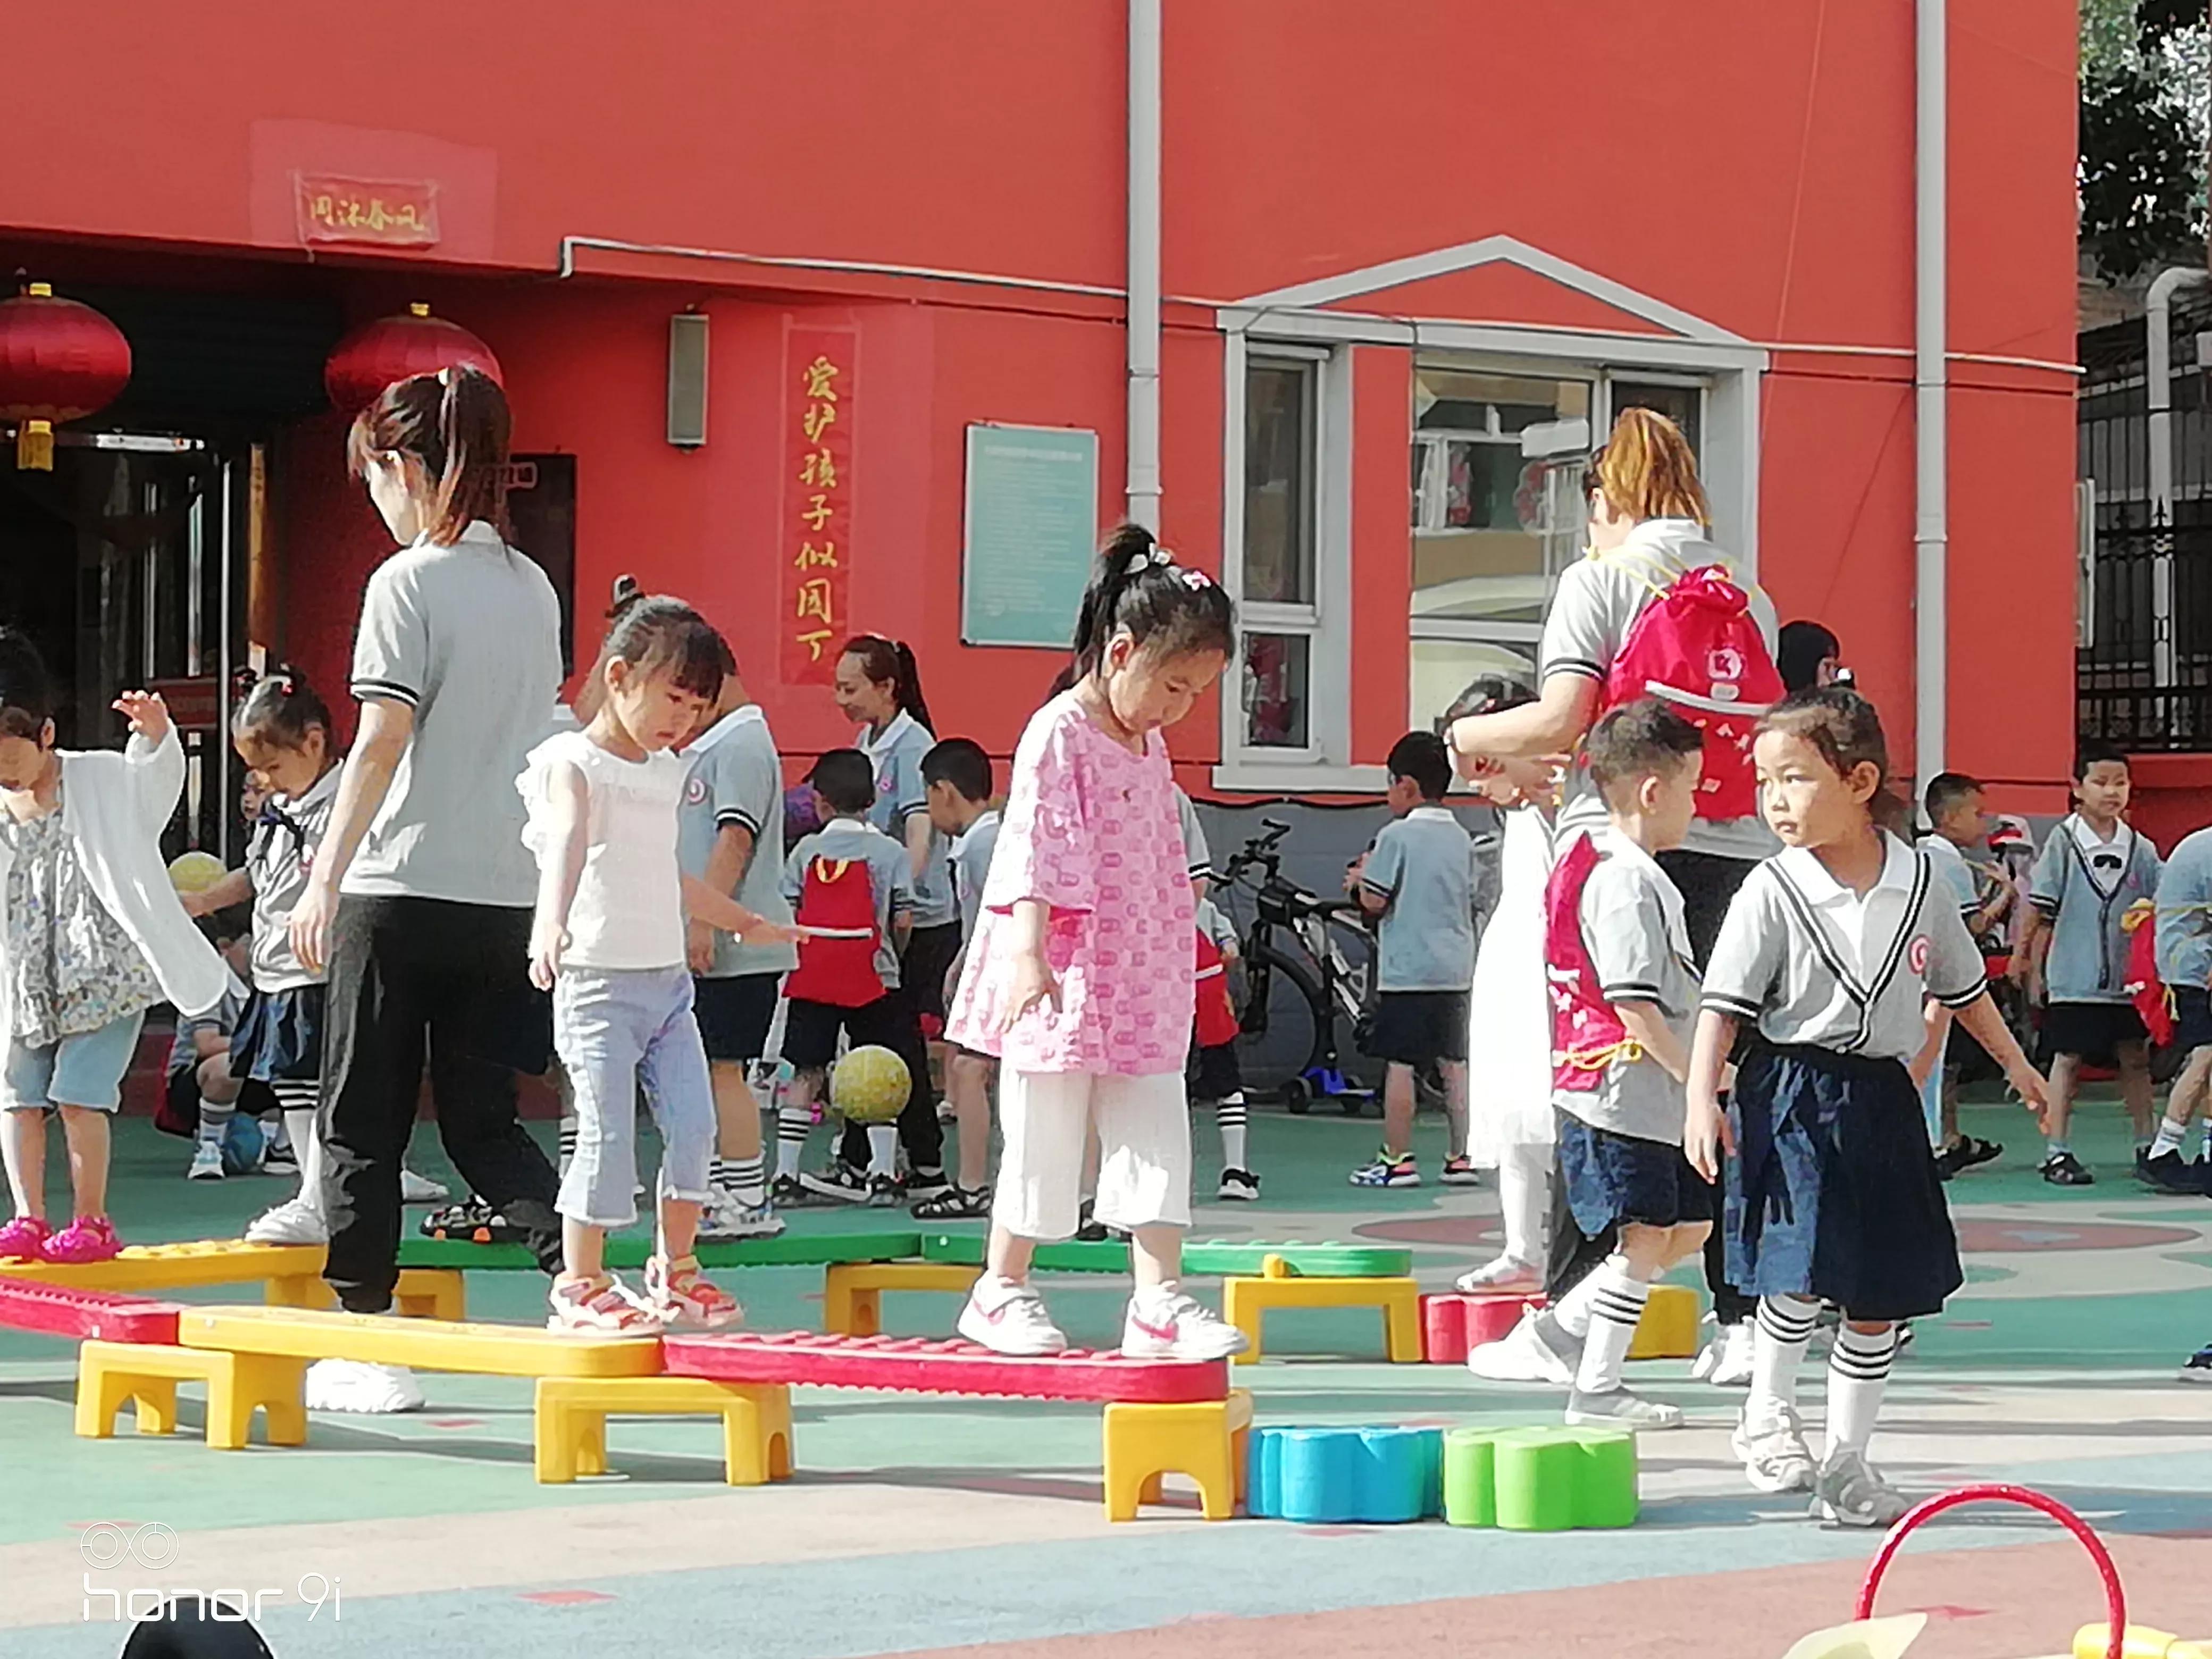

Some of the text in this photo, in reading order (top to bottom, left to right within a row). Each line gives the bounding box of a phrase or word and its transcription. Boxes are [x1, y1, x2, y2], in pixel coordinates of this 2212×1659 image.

[794, 355, 839, 661] 爱护孩子似园丁
